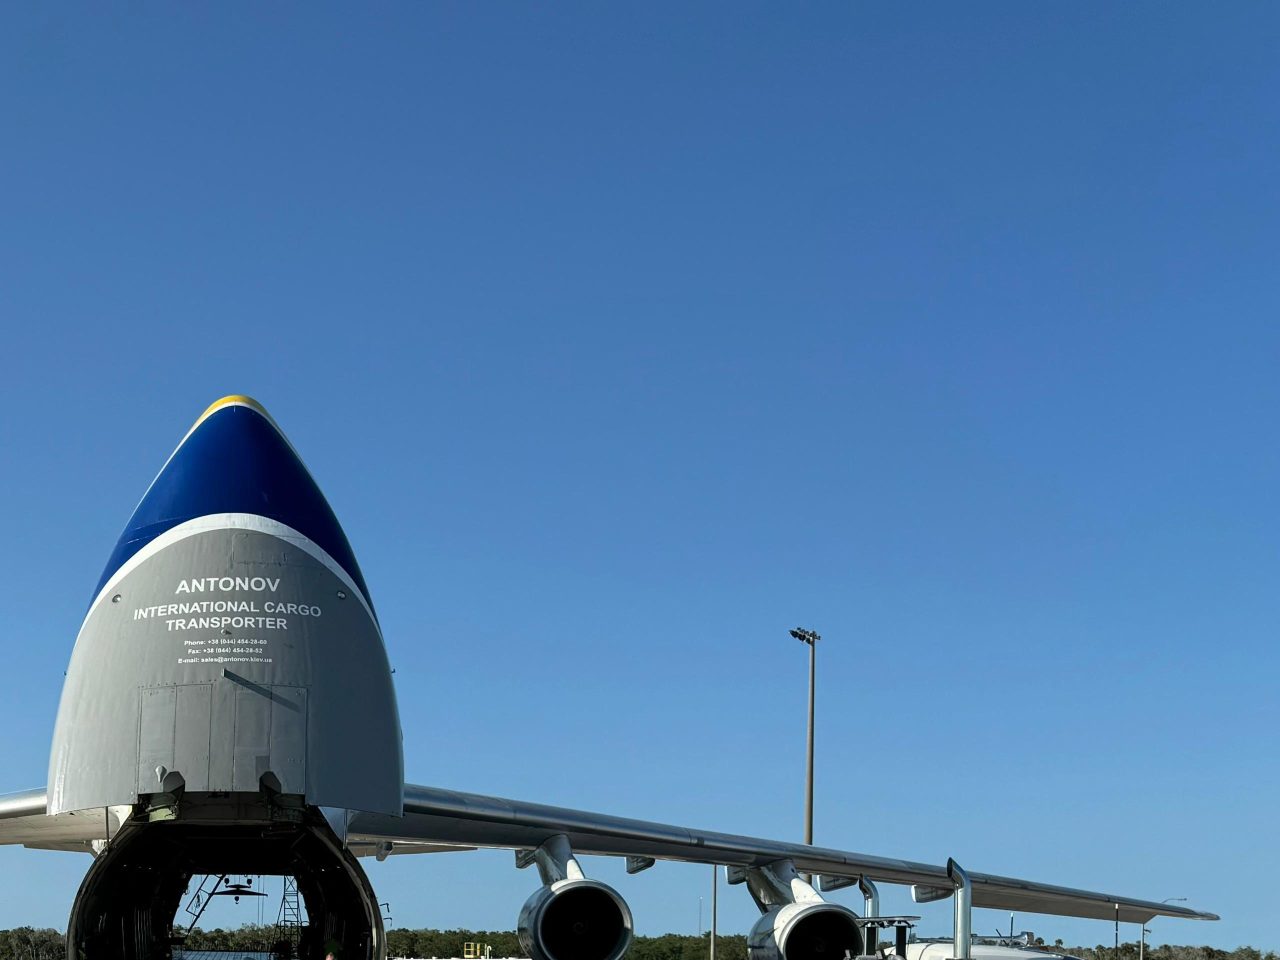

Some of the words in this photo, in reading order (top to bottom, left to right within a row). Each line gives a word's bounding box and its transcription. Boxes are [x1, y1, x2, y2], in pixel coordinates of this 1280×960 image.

[175, 576, 280, 594] ANTONOV
[133, 601, 260, 620] INTERNATIONAL
[264, 601, 322, 617] CARGO
[166, 616, 288, 631] TRANSPORTER
